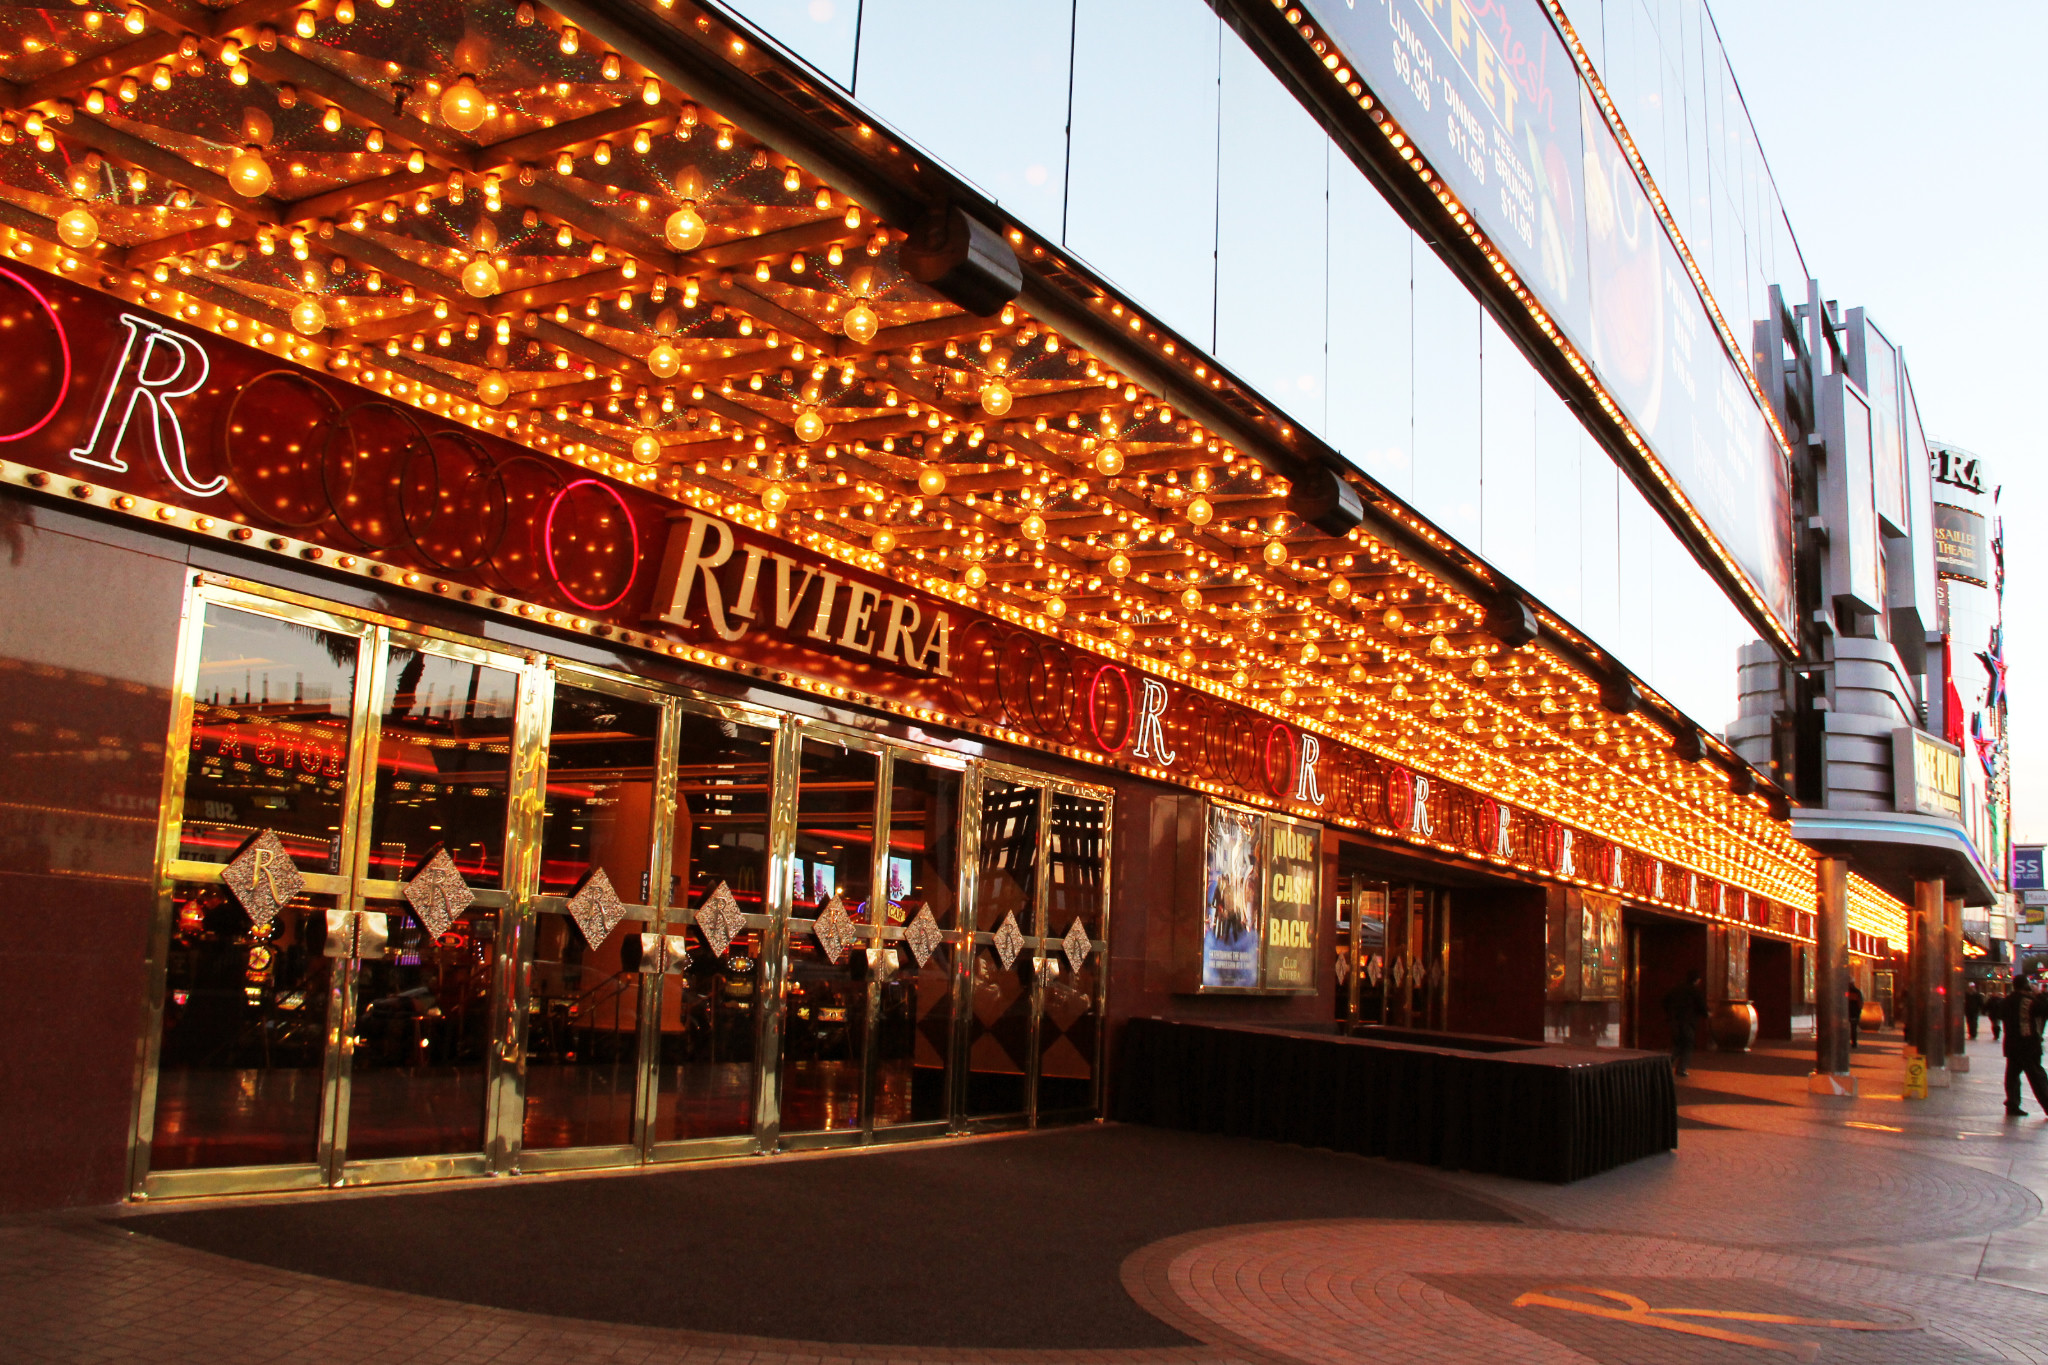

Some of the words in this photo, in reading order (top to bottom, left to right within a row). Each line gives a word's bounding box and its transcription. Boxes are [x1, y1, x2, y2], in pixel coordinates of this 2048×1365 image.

[1388, 0, 1433, 82] LUNCH
[1444, 76, 1486, 154] DINNER
[1424, 0, 1518, 136] FET
[1392, 39, 1431, 112] $9.99
[1447, 114, 1485, 186] $11.99
[1492, 124, 1533, 193] WEEKEND
[1494, 149, 1535, 223] BRUNCH
[1501, 187, 1533, 249] $11.99
[69, 312, 229, 497] R
[659, 509, 953, 678] RIVIERA
[1133, 677, 1176, 766] R
[1296, 733, 1325, 806] R
[1411, 775, 1434, 837] R
[1496, 805, 1514, 858] R
[250, 849, 287, 907] R
[1273, 828, 1313, 863] MORE
[1561, 828, 1576, 876] R
[1613, 846, 1625, 889] R
[1272, 873, 1311, 905] CASH
[1269, 917, 1312, 949] BACK.
